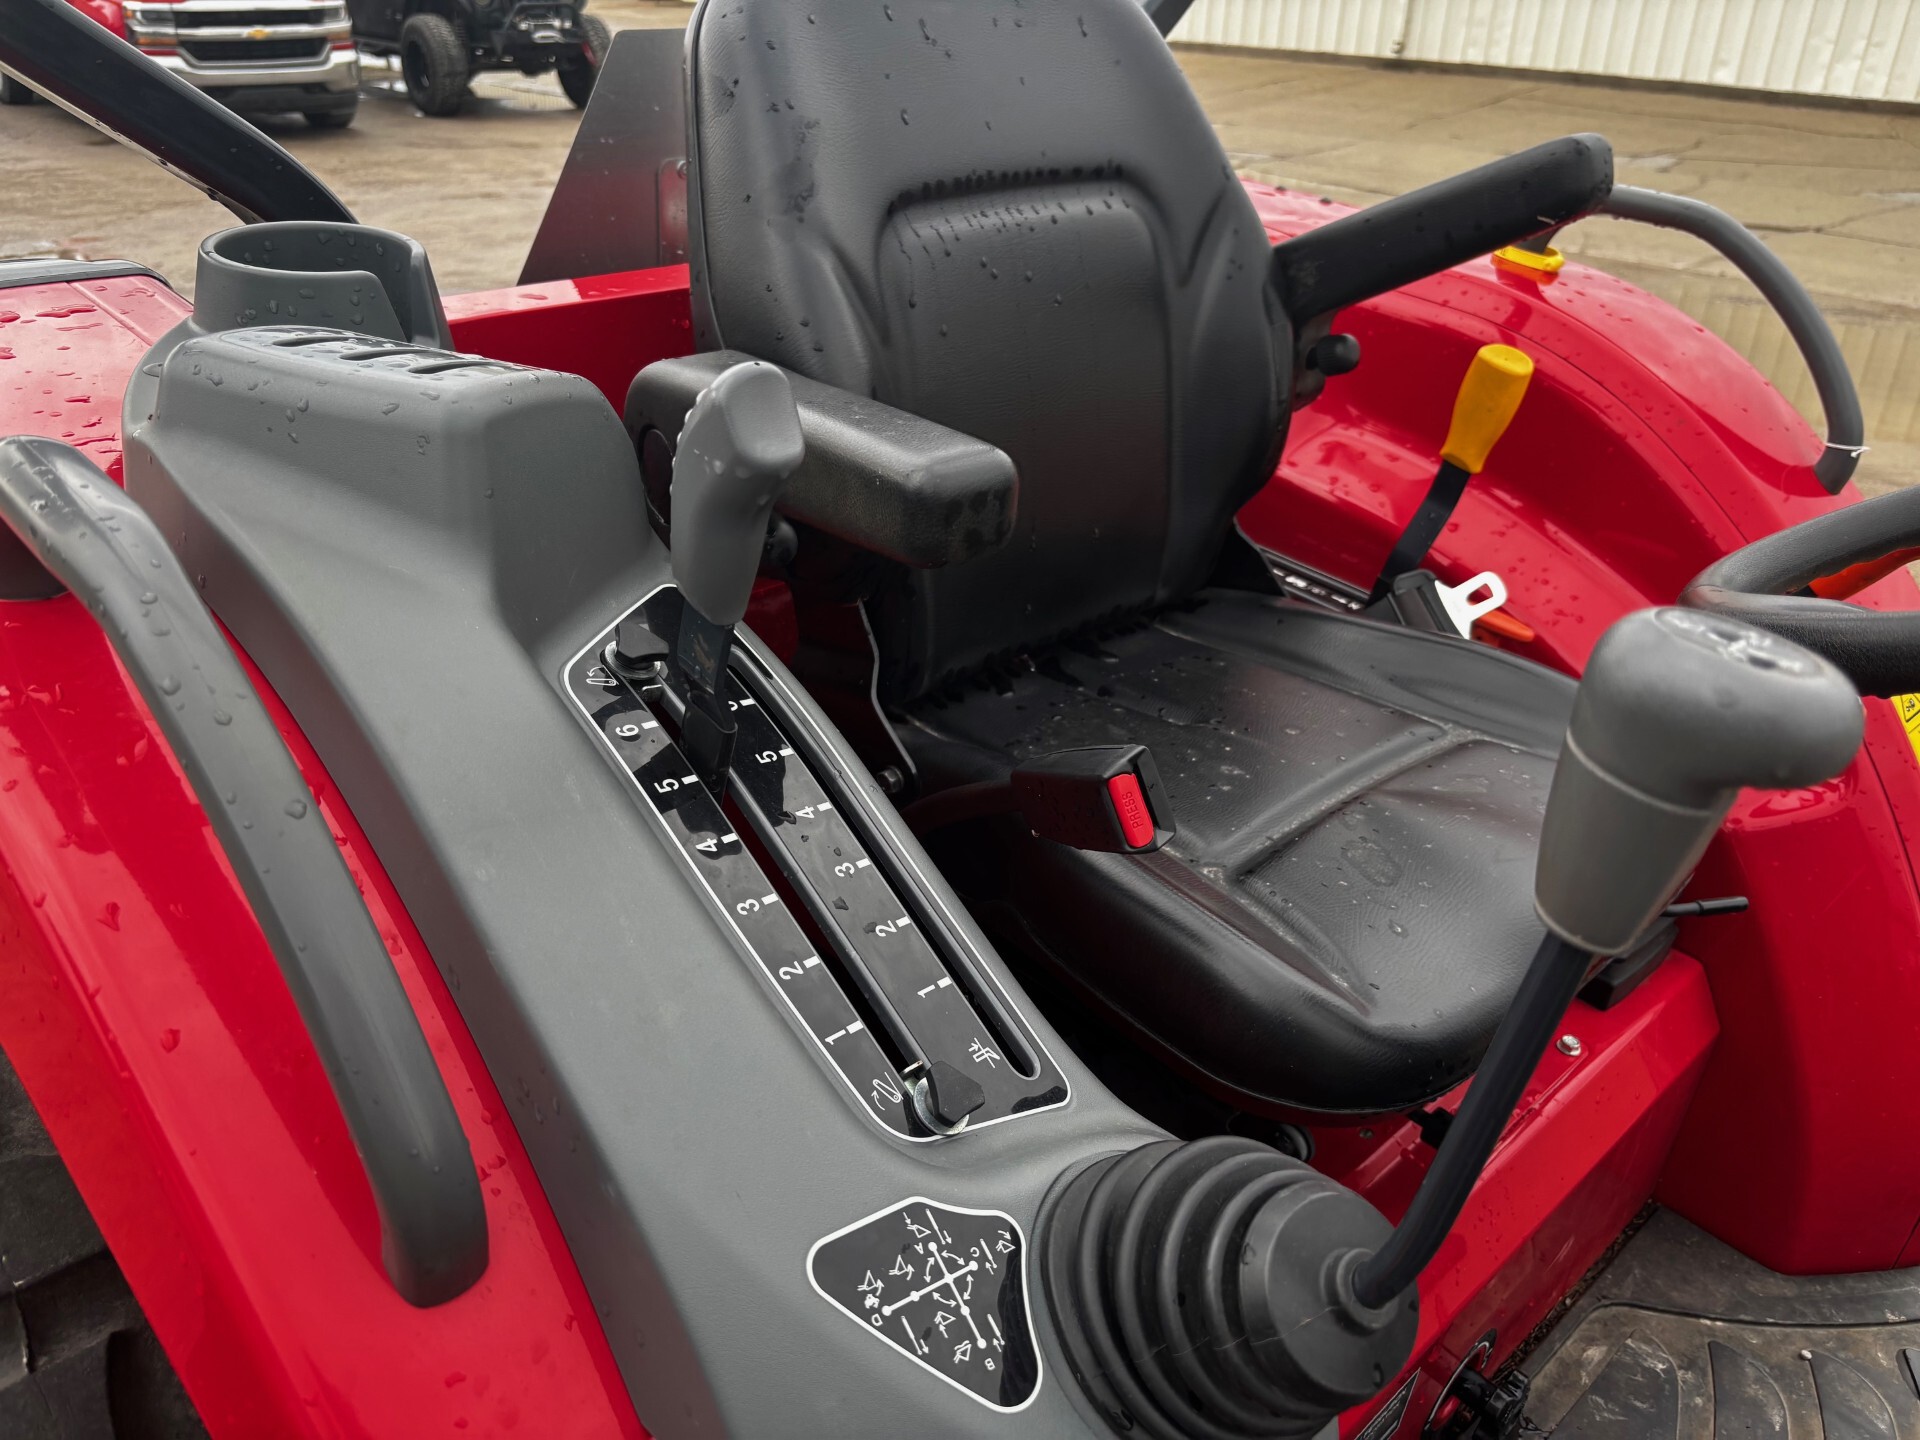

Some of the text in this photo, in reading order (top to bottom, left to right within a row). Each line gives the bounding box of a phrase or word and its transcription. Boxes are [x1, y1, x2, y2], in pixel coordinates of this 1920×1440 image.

[615, 723, 639, 738] 6
[755, 750, 778, 764] 5
[654, 778, 680, 795] 5
[795, 805, 815, 819] 4
[1121, 791, 1144, 829] PRESS
[695, 837, 718, 854] 4
[834, 861, 856, 878] 3
[736, 898, 760, 915] 3
[875, 919, 898, 937] 2
[778, 960, 804, 981] 2
[917, 981, 936, 998] 1
[824, 1027, 847, 1046] 1
[913, 1242, 924, 1255] A
[970, 1246, 980, 1258] C
[871, 1313, 884, 1327] D
[984, 1357, 996, 1371] B
